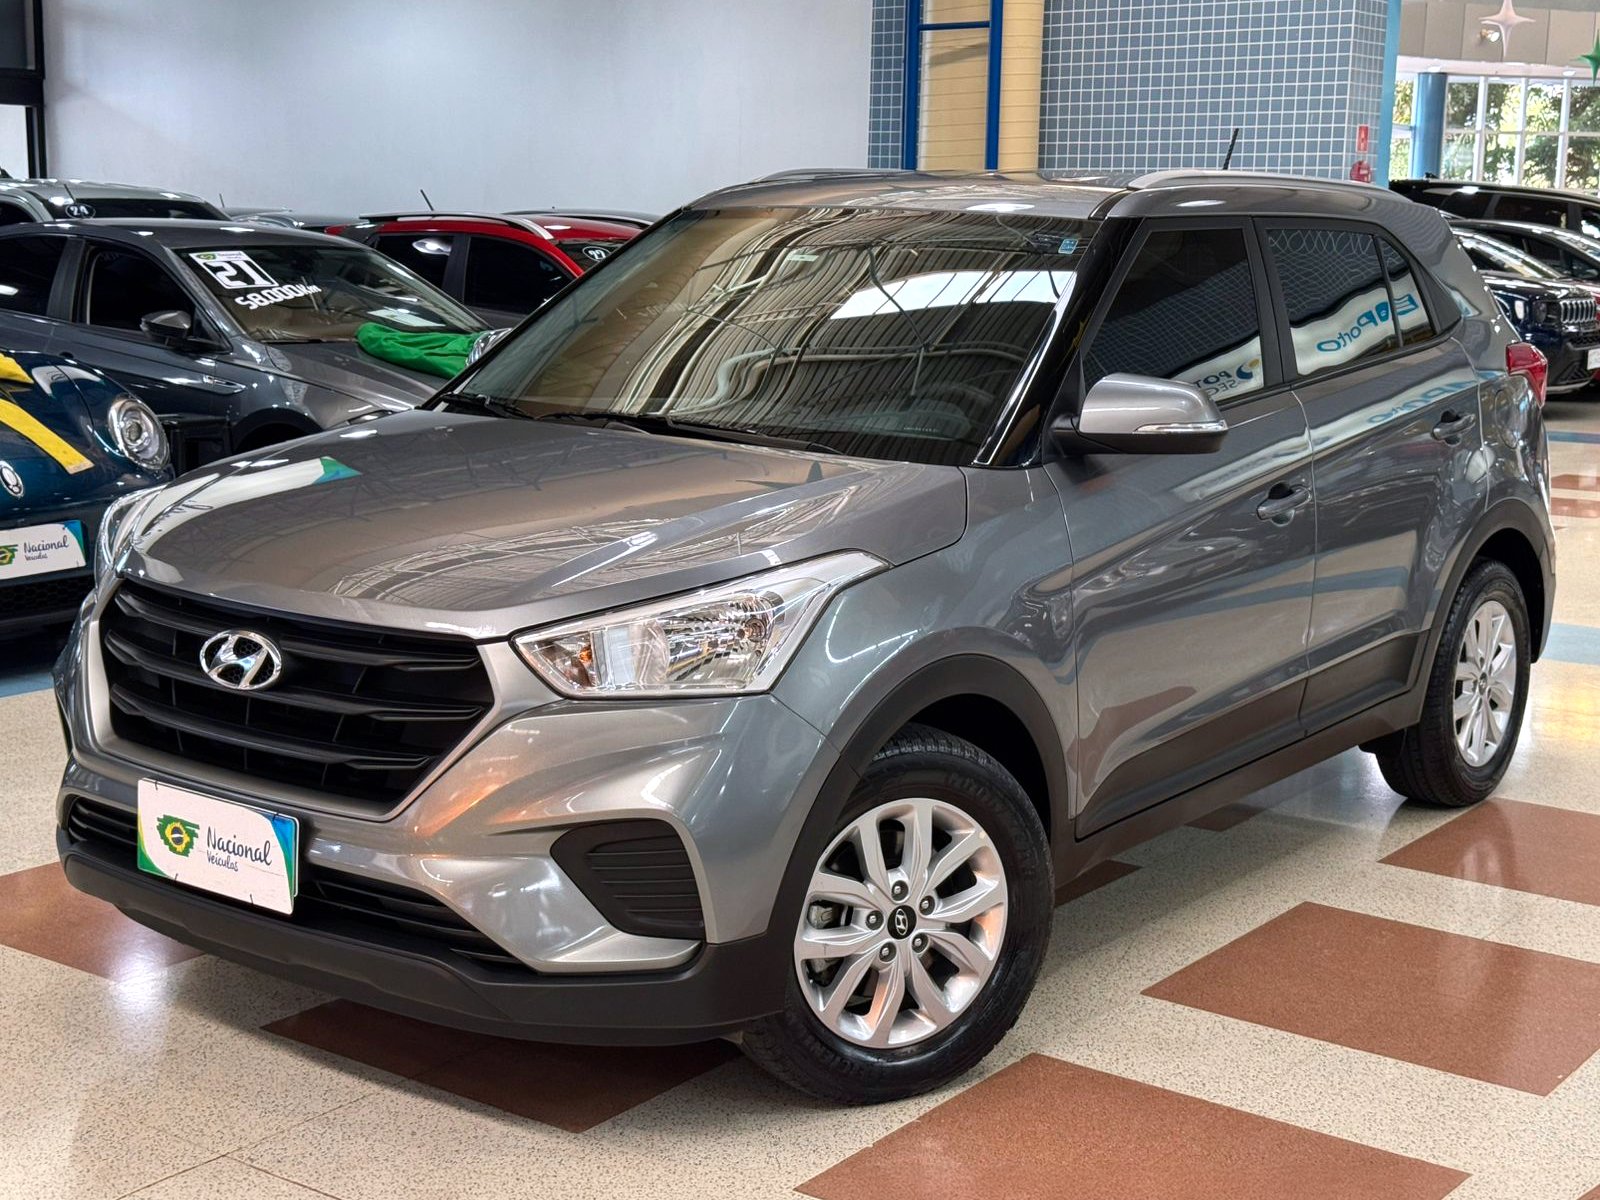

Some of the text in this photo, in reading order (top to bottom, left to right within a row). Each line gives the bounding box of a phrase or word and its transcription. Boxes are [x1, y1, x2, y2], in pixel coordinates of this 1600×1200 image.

[205, 260, 273, 286] 21
[23, 535, 69, 553] Nacional
[206, 826, 273, 866] Nacional
